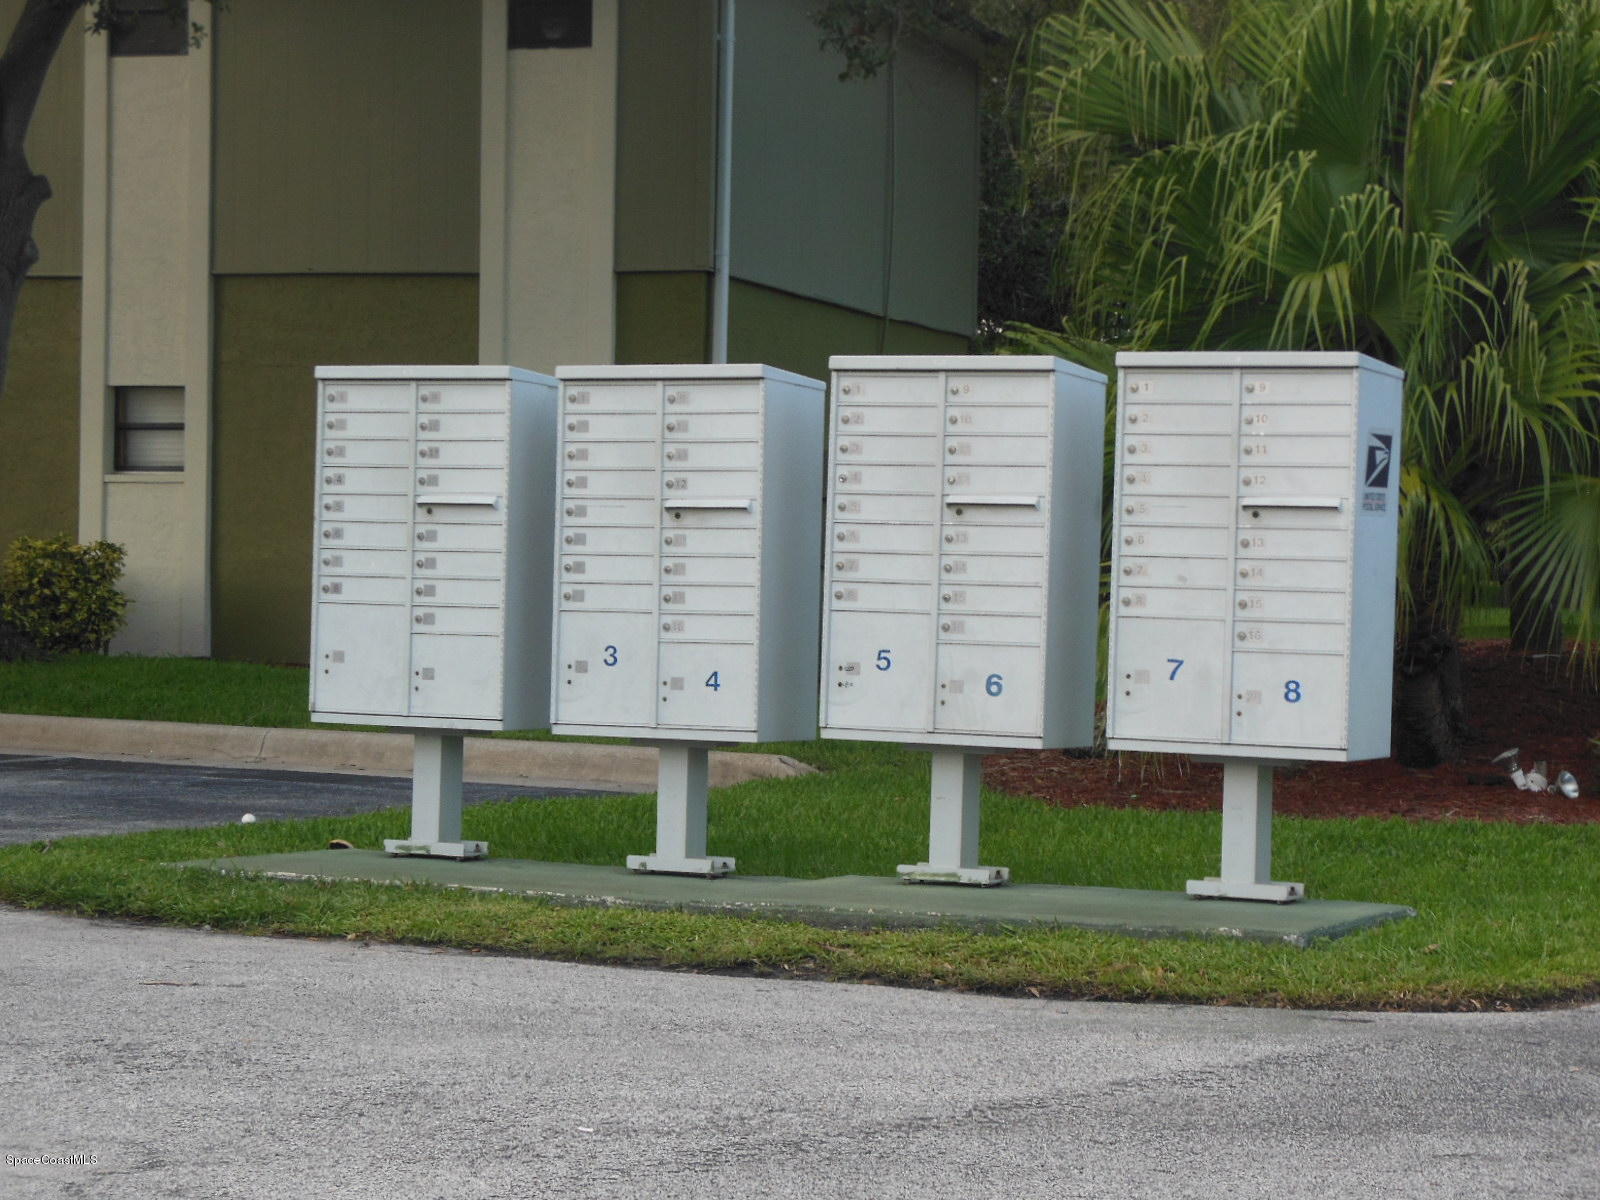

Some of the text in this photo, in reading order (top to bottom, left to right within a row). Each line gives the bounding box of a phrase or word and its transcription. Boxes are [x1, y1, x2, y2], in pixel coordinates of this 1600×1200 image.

[1256, 414, 1268, 423] 10
[1256, 444, 1266, 454] 11
[1255, 475, 1265, 485] 12
[1252, 538, 1263, 547] 13
[603, 645, 618, 667] 3
[876, 649, 891, 672] 5
[1167, 659, 1185, 680] 7
[705, 671, 721, 691] 4
[986, 674, 1003, 697] 6
[1284, 680, 1303, 703] 8
